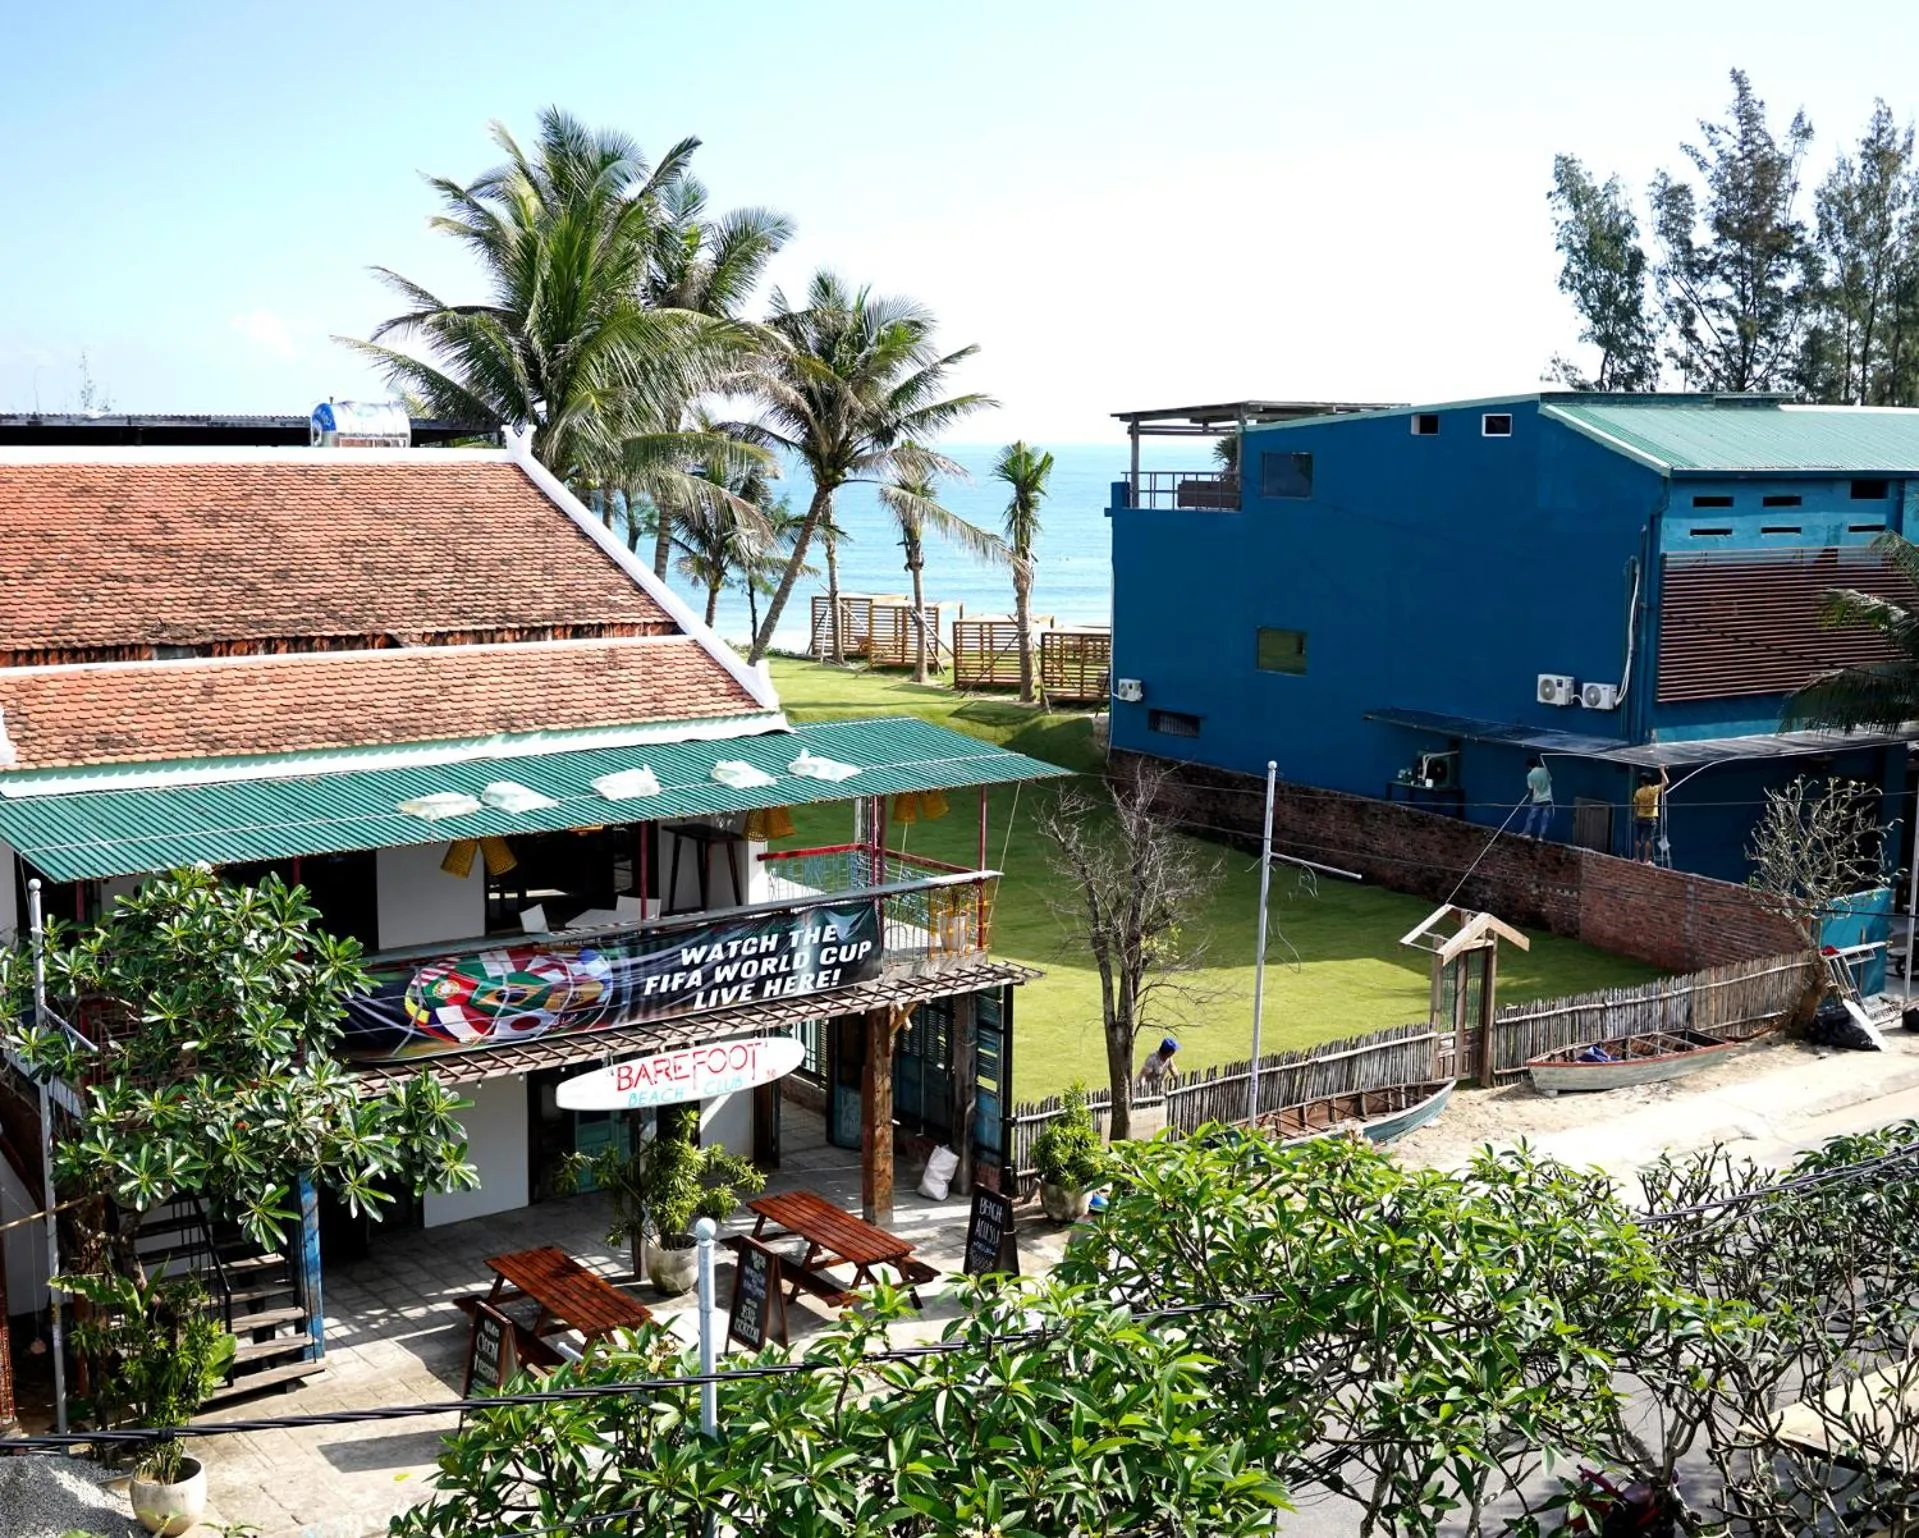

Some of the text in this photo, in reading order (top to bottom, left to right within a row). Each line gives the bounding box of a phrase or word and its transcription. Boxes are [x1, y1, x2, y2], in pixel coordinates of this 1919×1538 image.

[681, 924, 837, 966] WATCH THE
[644, 940, 872, 996] FIFA WORLD CUP
[693, 968, 841, 1011] LIVE HERE!
[617, 1042, 762, 1092] BAREFOOT
[628, 1076, 743, 1107] BEACH CLUB
